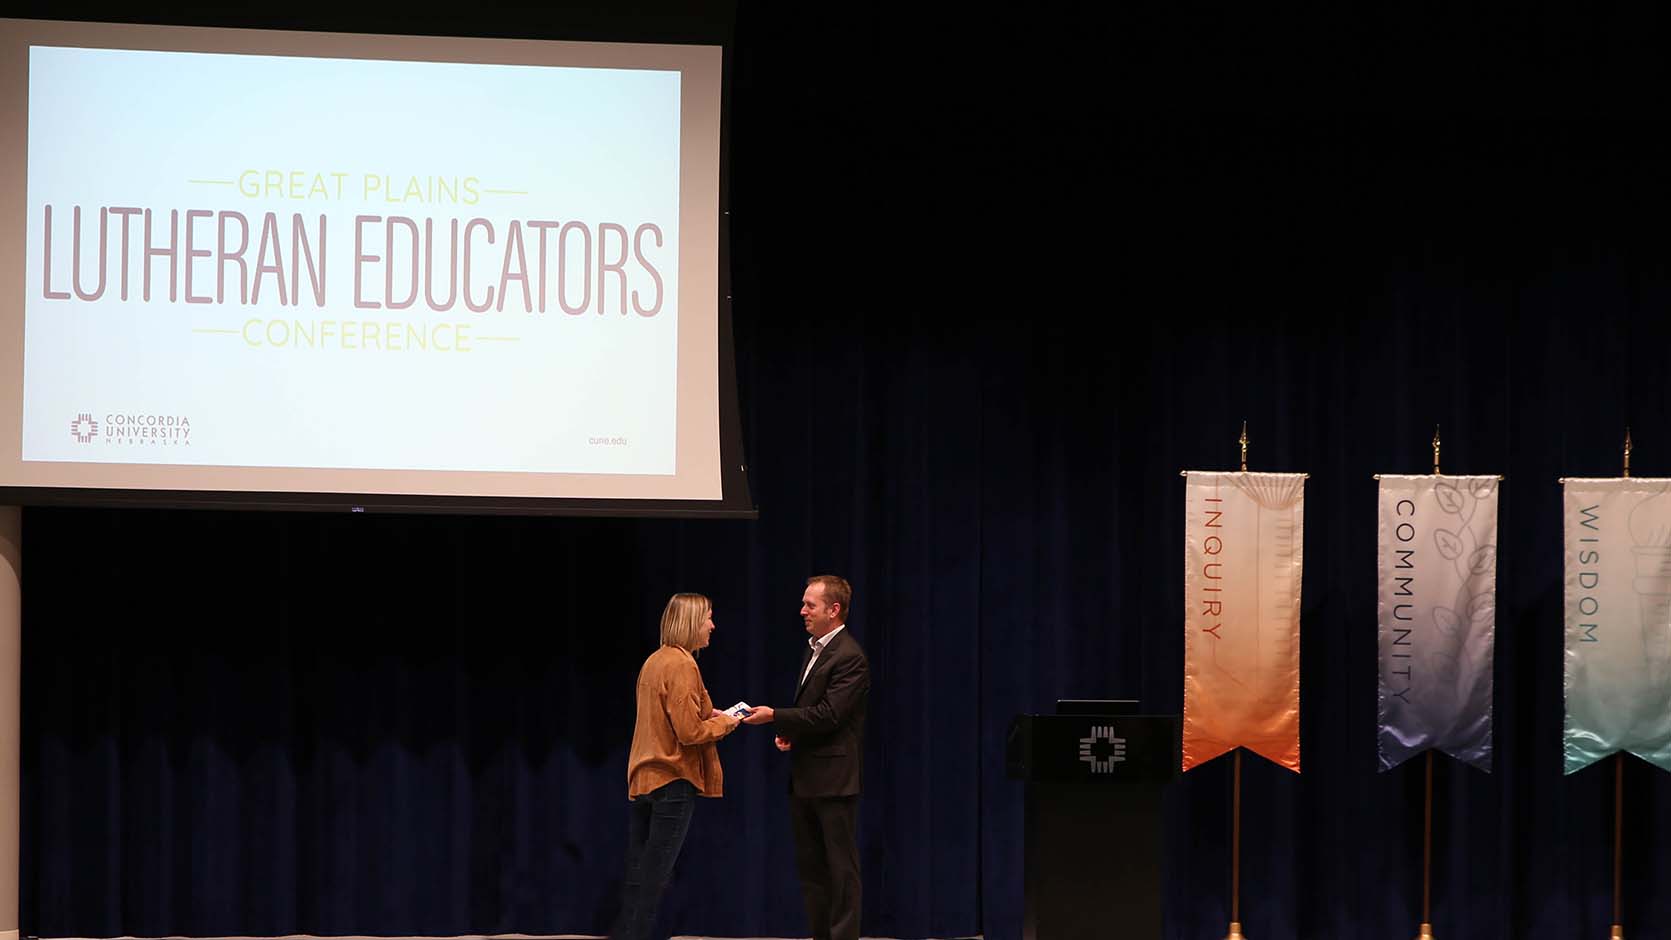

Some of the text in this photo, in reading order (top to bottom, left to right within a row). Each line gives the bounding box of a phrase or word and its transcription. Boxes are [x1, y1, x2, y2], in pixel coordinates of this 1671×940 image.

[238, 170, 481, 205] GREAT PLAINS
[43, 204, 665, 318] LUTHERAN EDUCATORS
[242, 319, 472, 352] CONFERENCE
[106, 414, 190, 426] CONCORDIA
[106, 426, 190, 438] UNIVERSITY
[1202, 498, 1223, 640] INQUIRY
[1392, 499, 1416, 704] COMMUNITY
[1578, 504, 1600, 643] WISDOM
